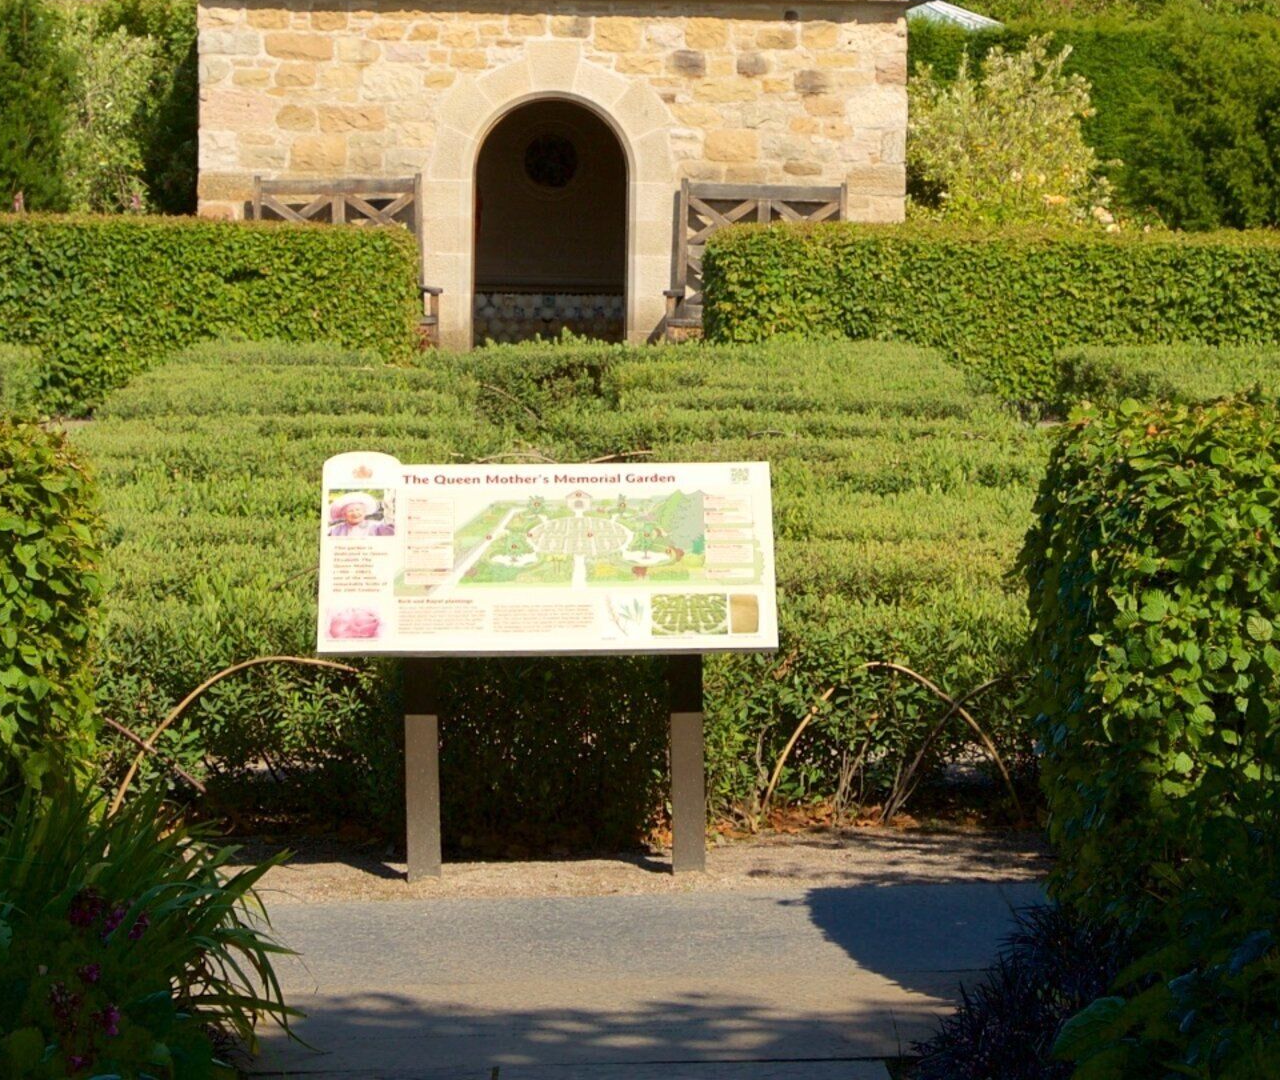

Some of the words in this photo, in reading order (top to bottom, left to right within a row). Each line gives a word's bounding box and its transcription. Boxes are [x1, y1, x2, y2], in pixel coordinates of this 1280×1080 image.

[402, 474, 430, 485] The
[433, 474, 481, 485] Queen
[485, 474, 550, 484] Mother's
[553, 473, 622, 484] Memorial
[625, 473, 676, 483] Garden
